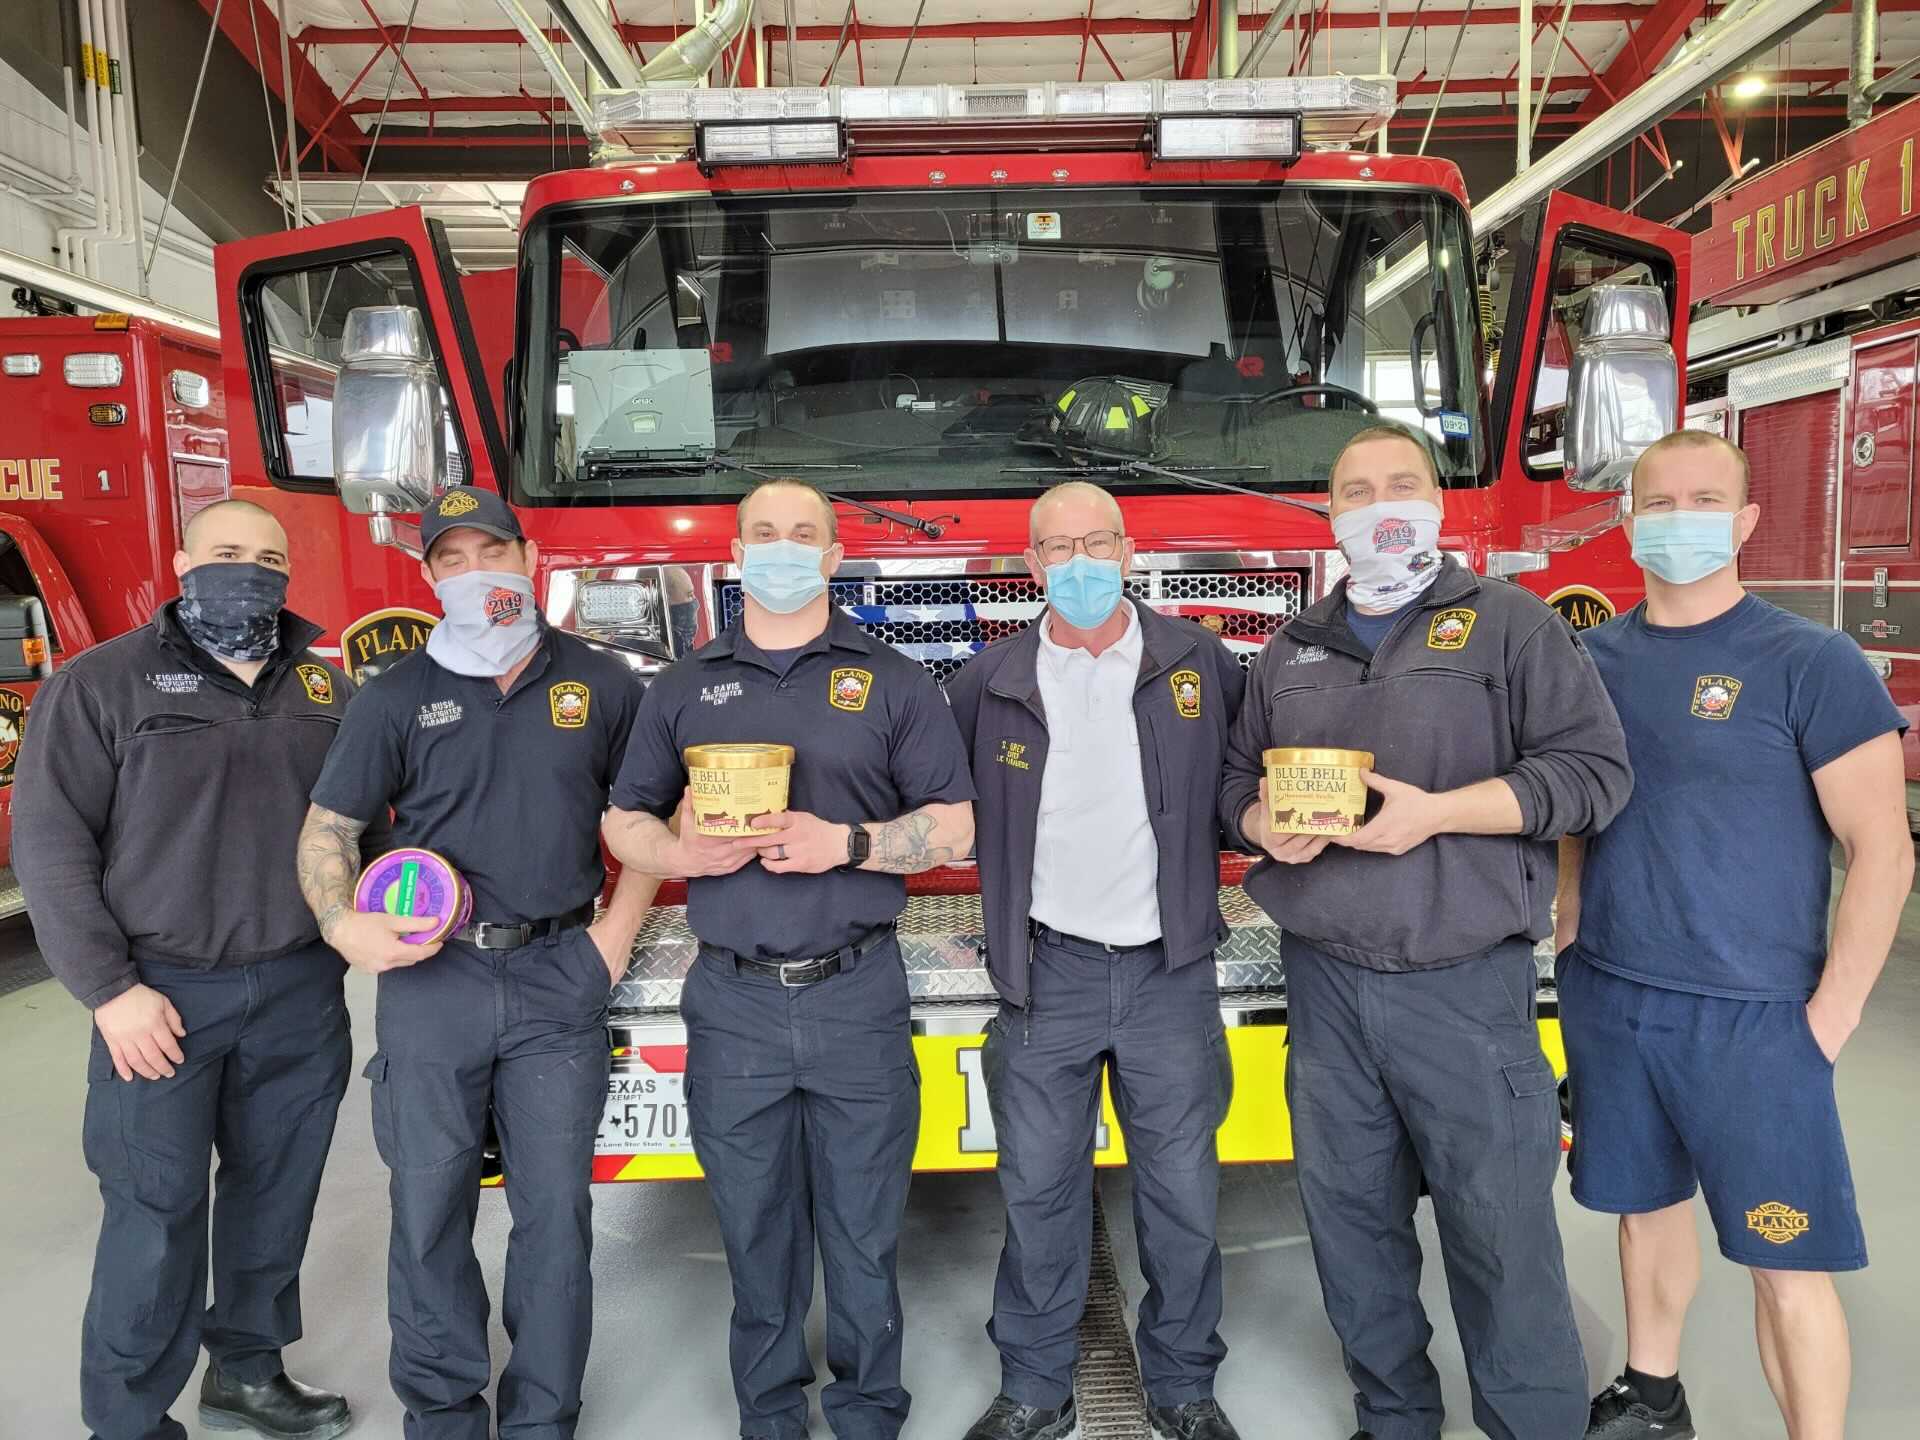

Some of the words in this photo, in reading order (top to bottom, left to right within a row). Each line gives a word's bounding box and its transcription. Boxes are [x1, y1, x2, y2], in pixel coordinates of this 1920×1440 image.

[1732, 158, 1871, 281] TRUCK
[1900, 137, 1914, 216] 1
[0, 458, 63, 500] CUE
[97, 469, 111, 492] 1
[1376, 526, 1412, 544] 2149
[488, 592, 522, 616] 2149
[1437, 611, 1472, 622] PLANO
[1554, 601, 1608, 628] ANO
[835, 671, 869, 681] PLANO
[1174, 674, 1198, 684] PLANO
[555, 685, 585, 695] PLANO
[713, 681, 740, 694] DAVIS
[1701, 678, 1740, 690] PLANO
[700, 689, 743, 703] FIREFIGHTER
[431, 699, 454, 711] BUSH
[418, 705, 462, 721] FIREFIGHTER
[421, 713, 461, 728] PARAMEDIC
[700, 771, 730, 783] BELL
[1275, 767, 1308, 779] BLUE
[1312, 768, 1347, 781] BELL
[1276, 780, 1294, 791] ICE
[1296, 781, 1346, 793] CREAM
[608, 1079, 656, 1093] EXAS
[1747, 1214, 1808, 1229] PLANO
